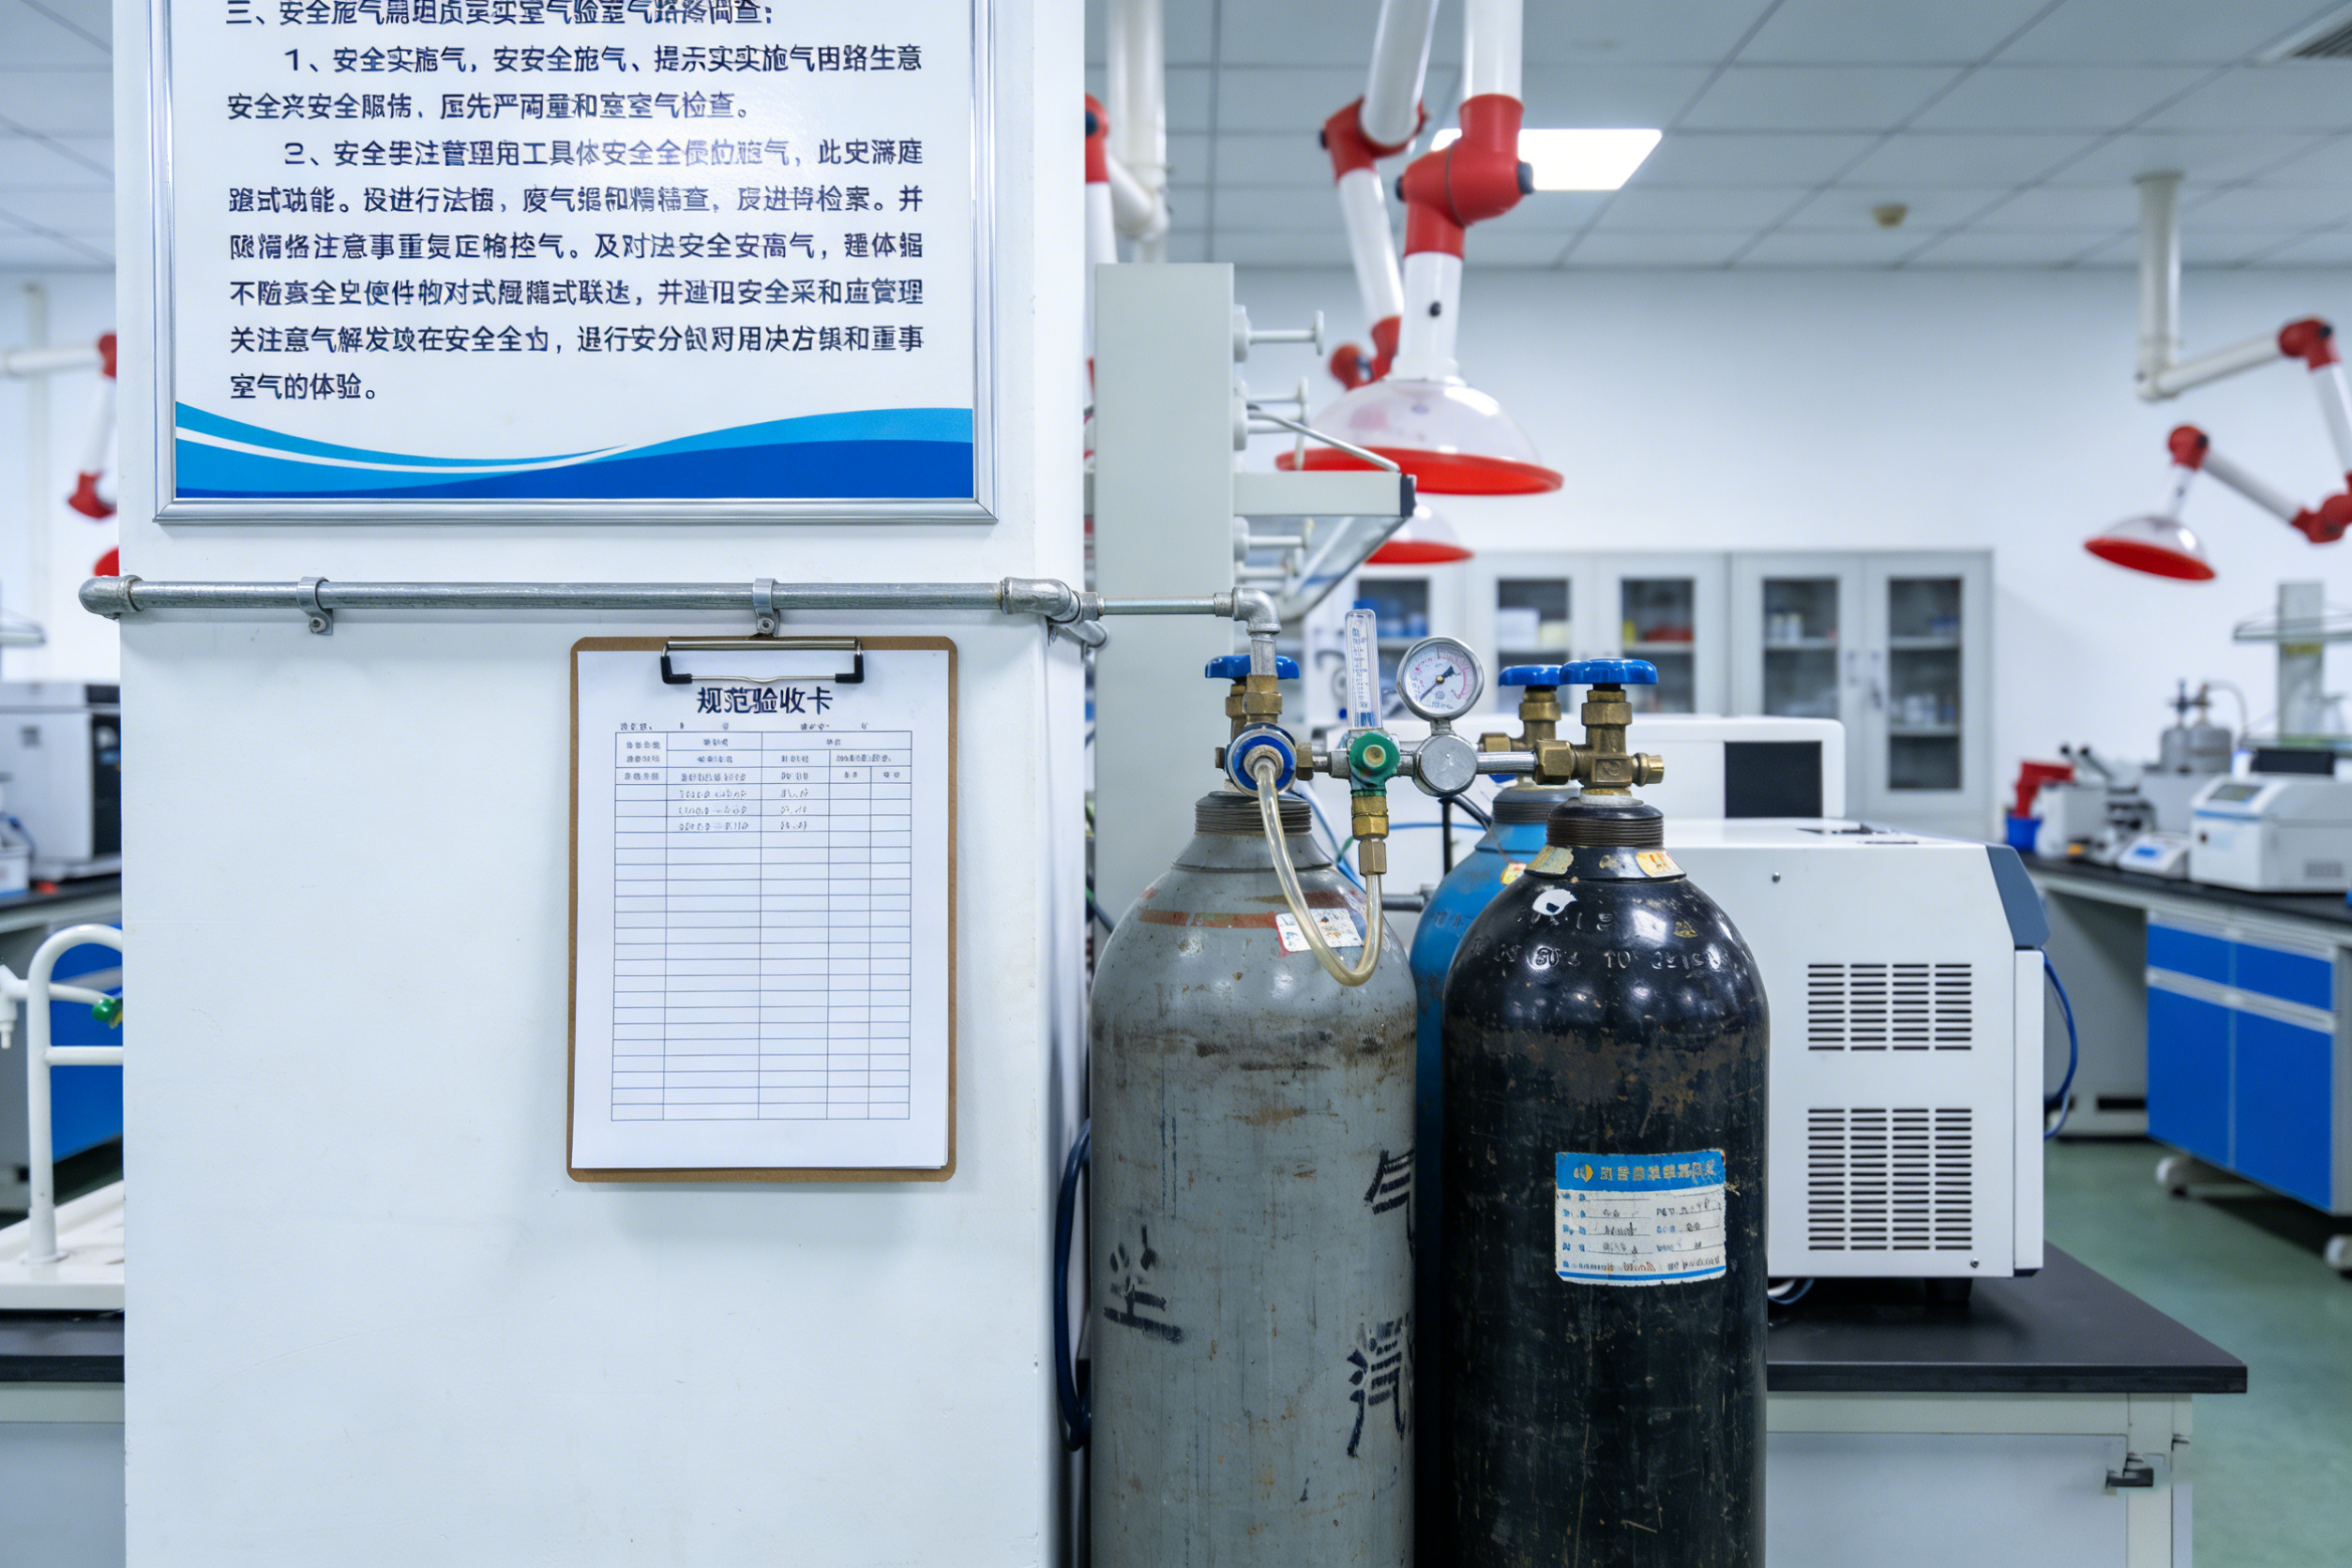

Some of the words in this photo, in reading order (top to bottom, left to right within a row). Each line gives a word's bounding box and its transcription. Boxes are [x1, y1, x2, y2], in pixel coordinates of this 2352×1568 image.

[697, 686, 834, 715] 规范验收卡
